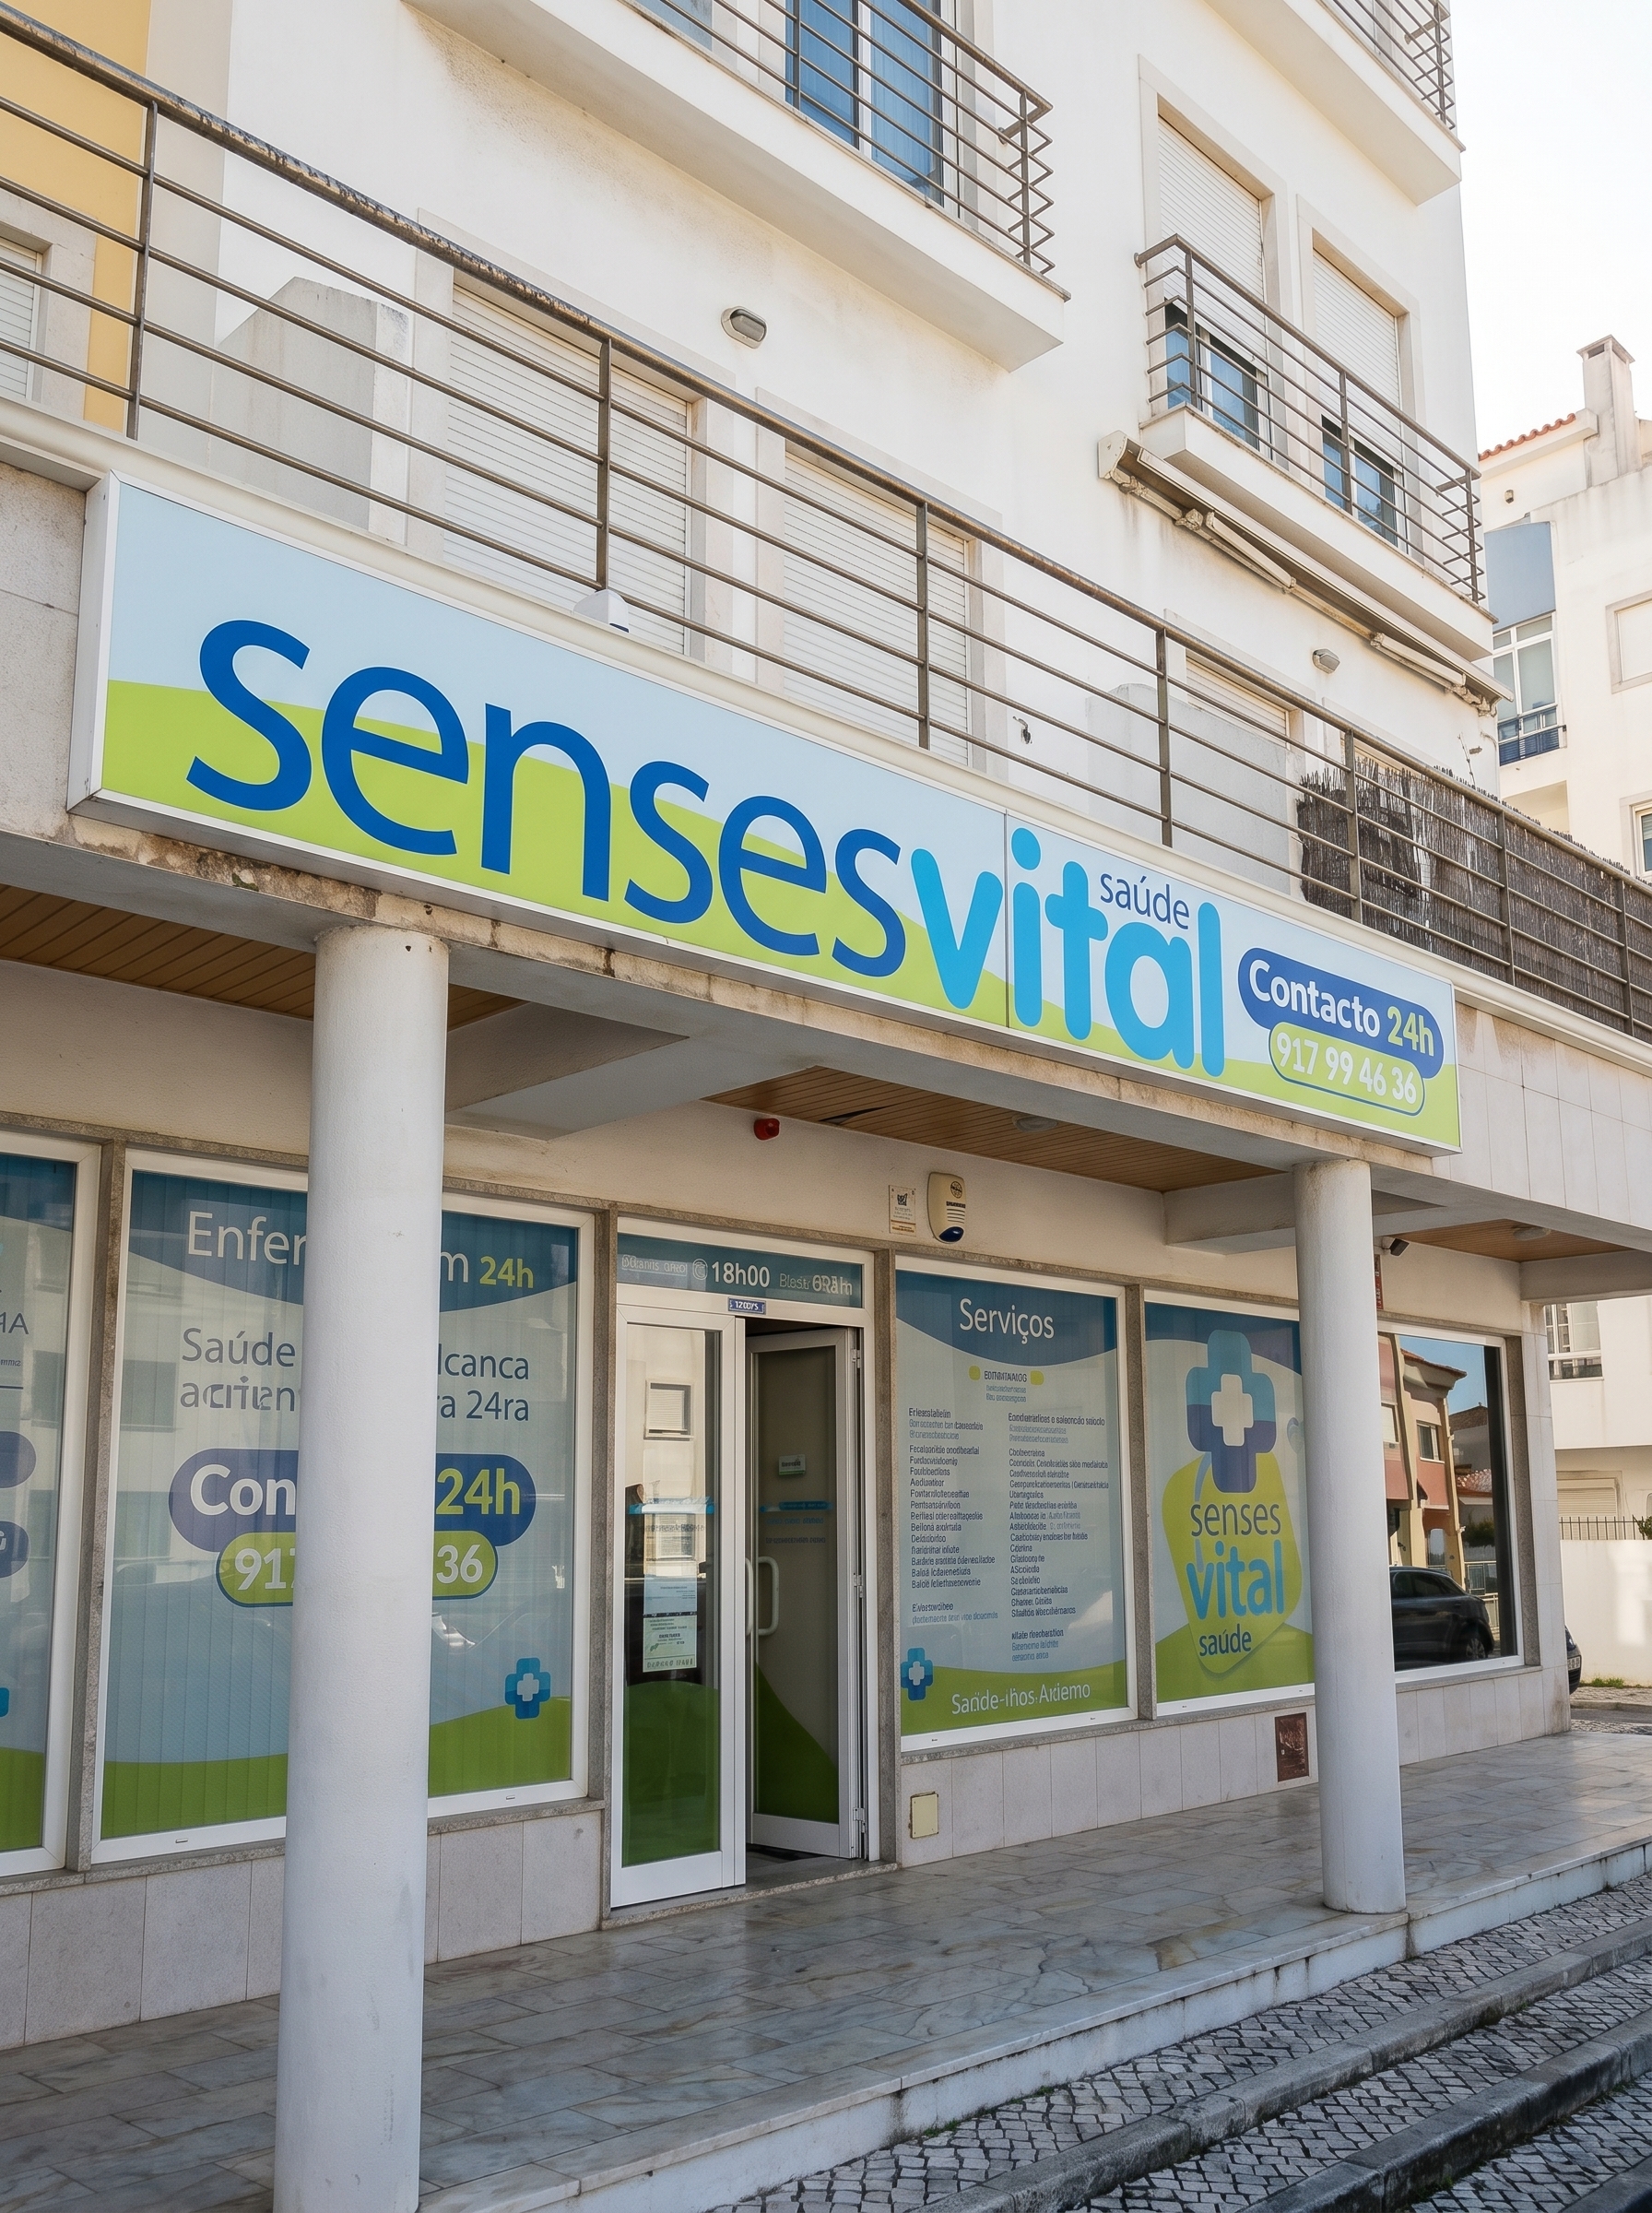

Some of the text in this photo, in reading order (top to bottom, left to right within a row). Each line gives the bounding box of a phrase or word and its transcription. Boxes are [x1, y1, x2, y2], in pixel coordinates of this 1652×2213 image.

[1101, 871, 1190, 930] saúde
[1249, 959, 1434, 1057] Contacto 24h
[1276, 1032, 1417, 1105] 917 99 46 36
[479, 1256, 534, 1288] 24h
[712, 1261, 770, 1288] 18h00
[960, 1298, 1055, 1344] Serviços
[182, 1327, 296, 1367] Saúde
[466, 1390, 529, 1421] 24ra
[435, 1467, 520, 1515] 24h
[1190, 1503, 1281, 1537] senses
[436, 1544, 483, 1584] 36
[1186, 1539, 1284, 1620] vital
[1198, 1623, 1252, 1657] saúde
